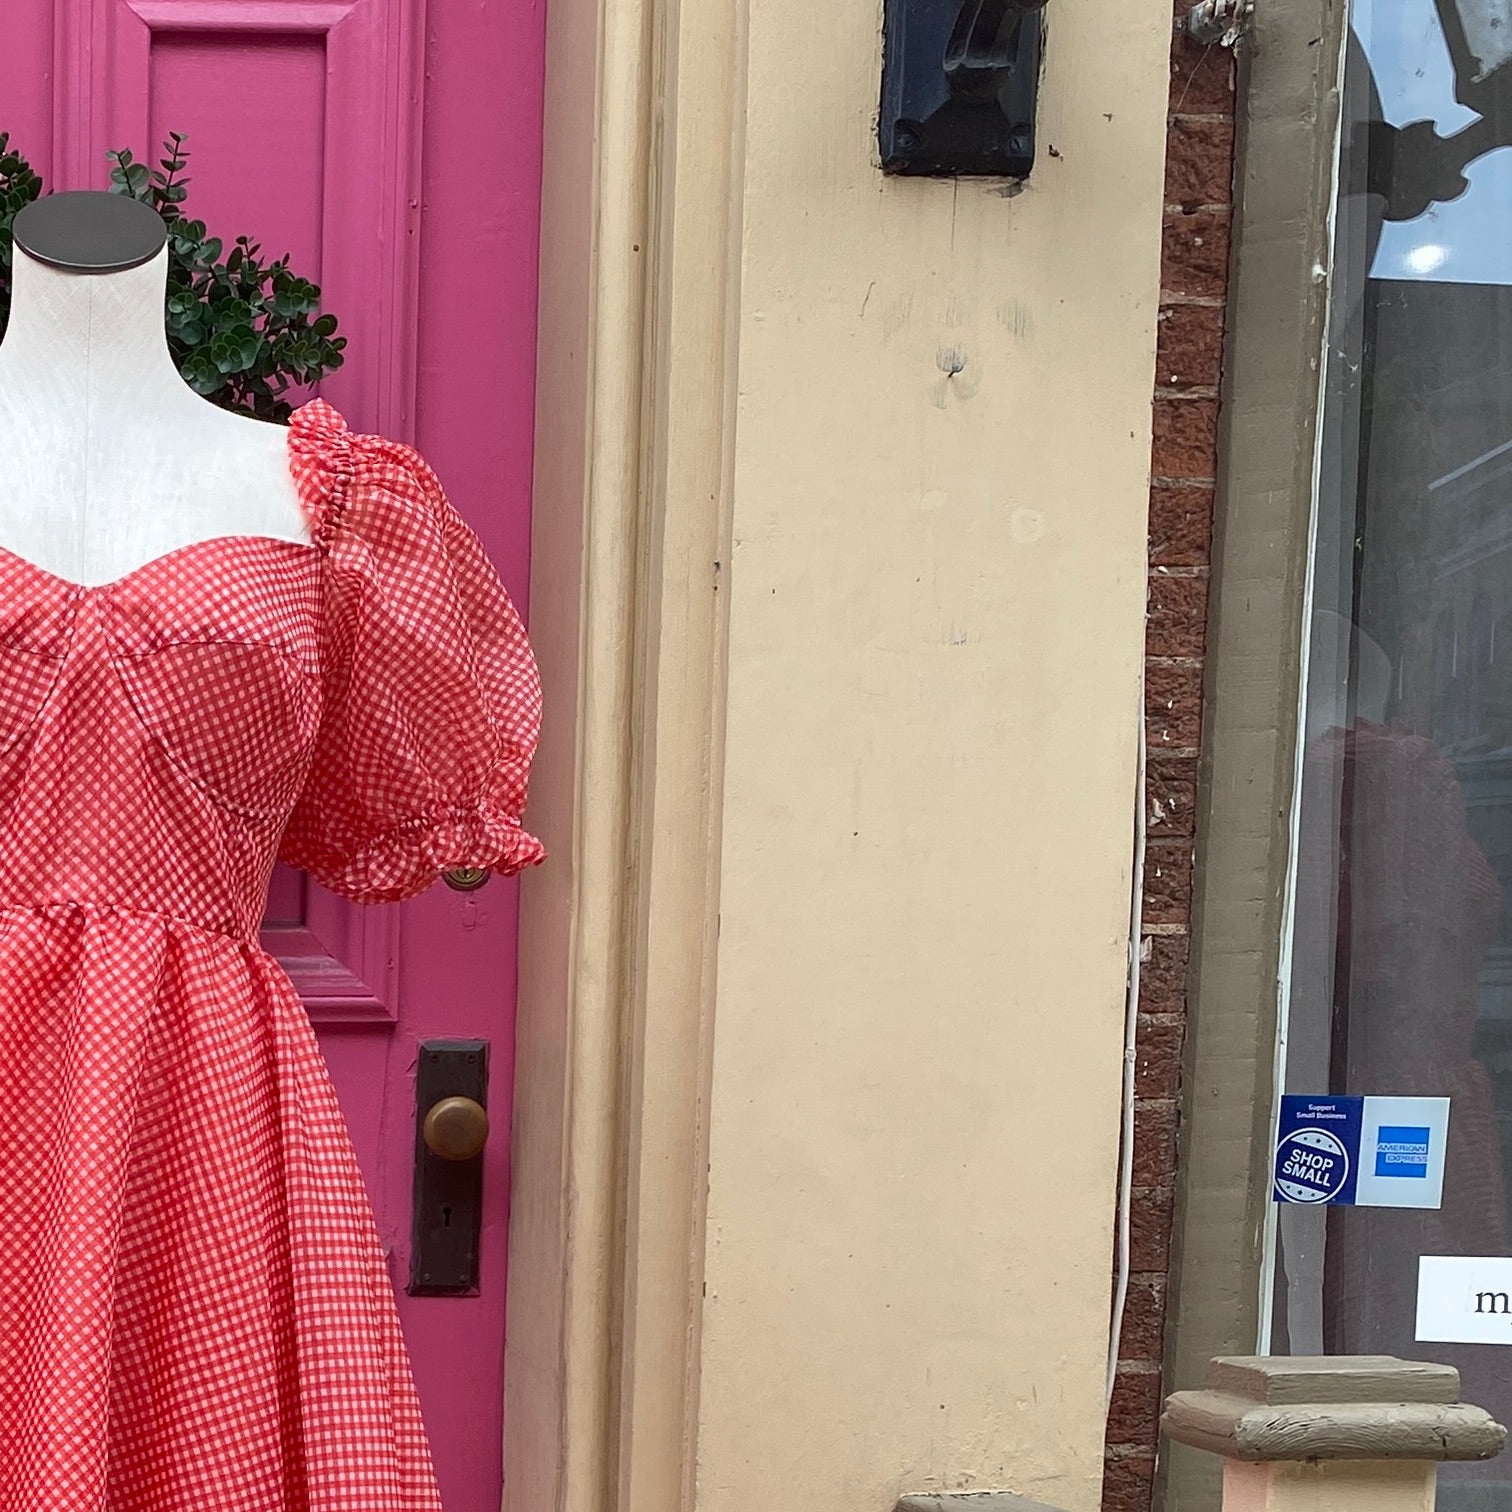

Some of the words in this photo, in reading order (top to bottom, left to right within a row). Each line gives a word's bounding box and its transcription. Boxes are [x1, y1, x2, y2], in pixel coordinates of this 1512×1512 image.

[1377, 1143, 1426, 1152] AMERICAN
[1386, 1154, 1428, 1162] EXPRESS
[1290, 1149, 1334, 1171] SHOP
[1282, 1161, 1331, 1187] SMALL
[1473, 1291, 1512, 1316] m
